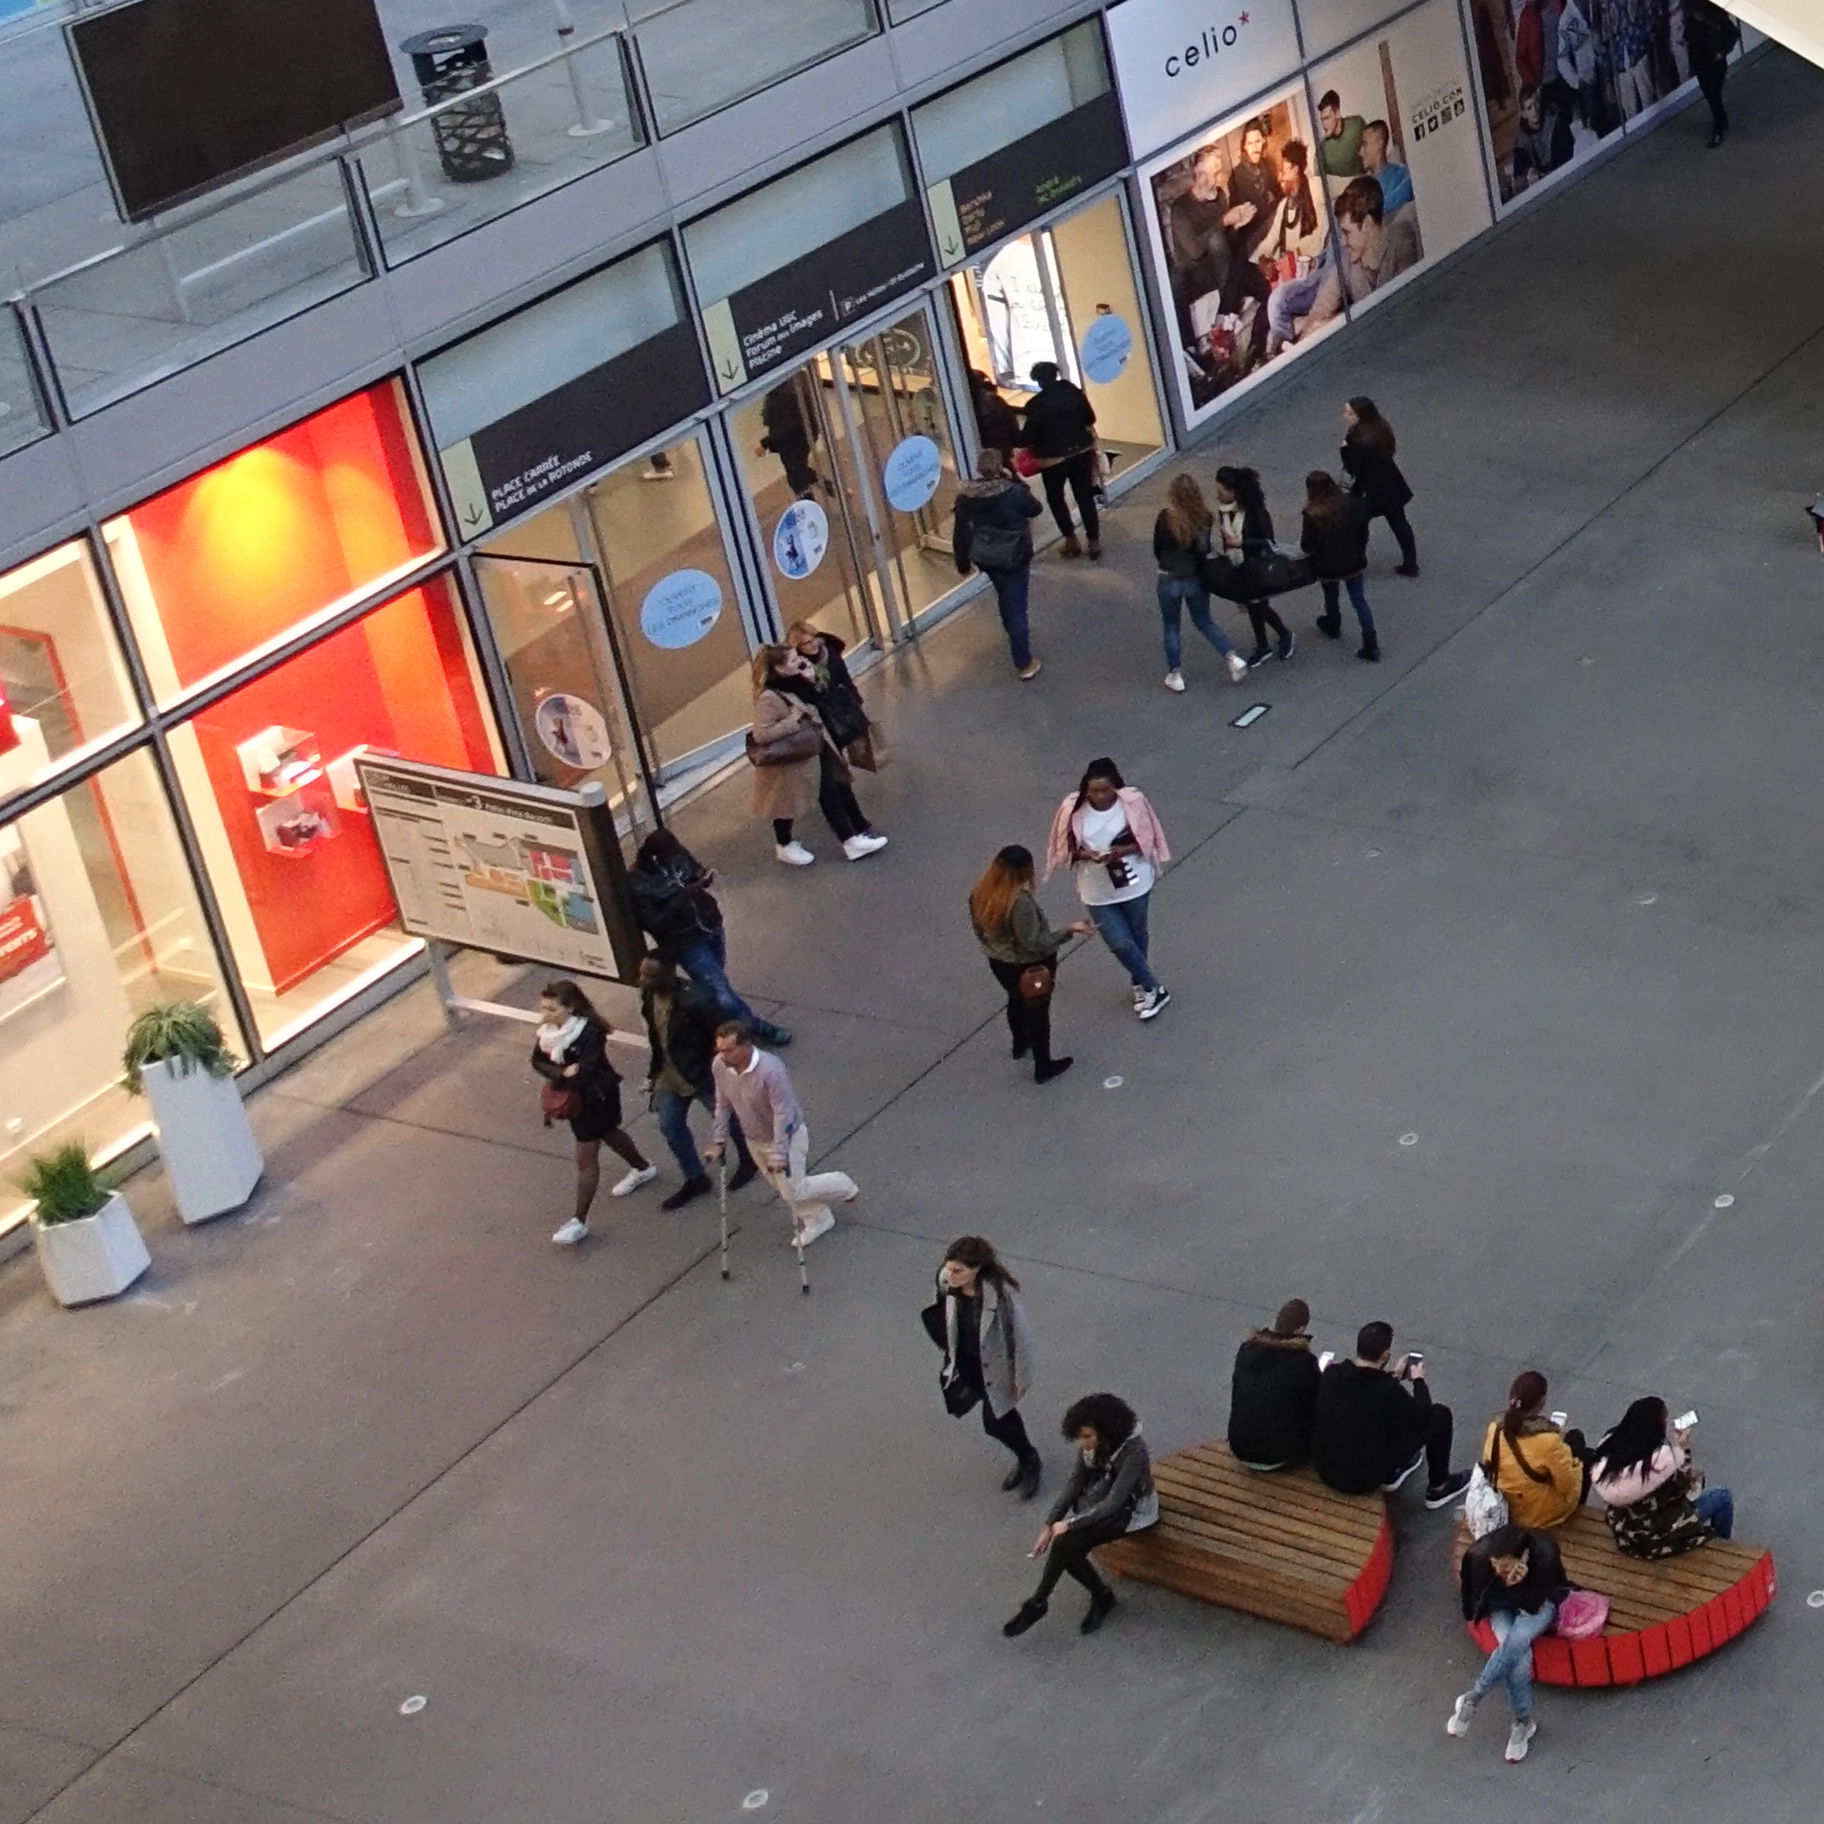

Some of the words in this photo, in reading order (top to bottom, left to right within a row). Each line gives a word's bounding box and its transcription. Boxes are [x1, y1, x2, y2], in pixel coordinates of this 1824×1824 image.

[743, 322, 778, 347] Cinéma
[745, 335, 777, 358] Forum
[748, 345, 783, 370] Piscine
[491, 475, 524, 500] PLACE
[523, 454, 562, 483] CARRÉE
[494, 489, 527, 513] PLACE
[548, 450, 594, 483] ROTONDE
